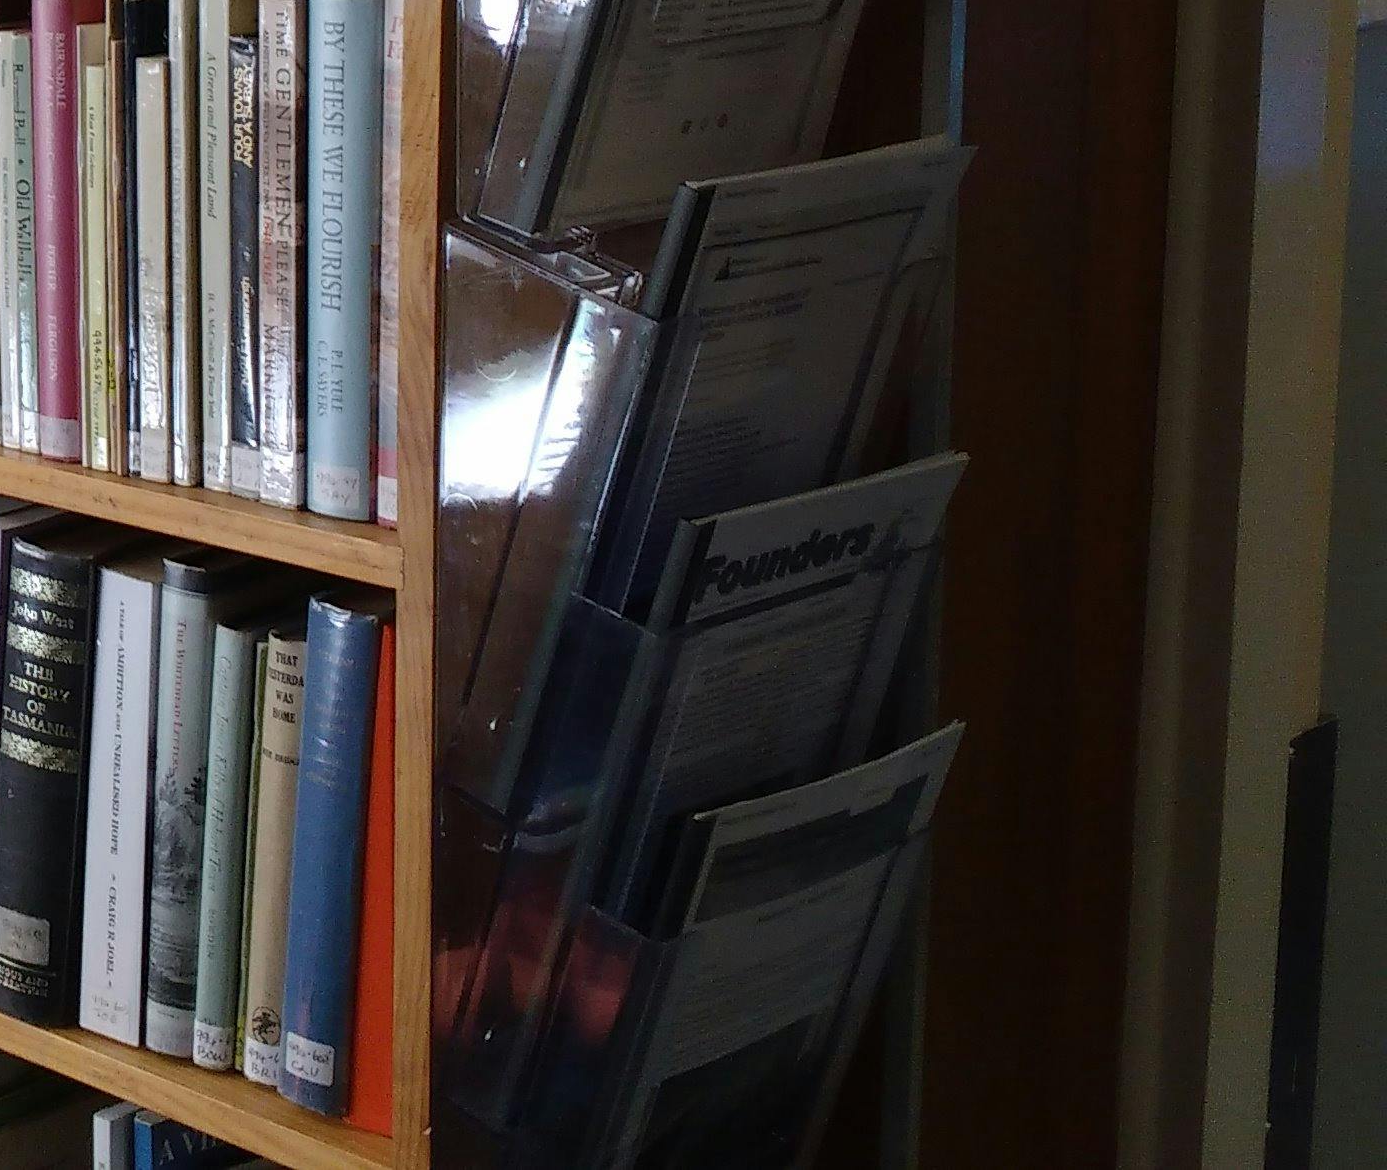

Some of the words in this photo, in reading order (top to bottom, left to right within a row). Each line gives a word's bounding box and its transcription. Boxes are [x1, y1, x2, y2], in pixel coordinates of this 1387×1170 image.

[320, 20, 346, 53] BY
[206, 67, 218, 99] Green
[320, 59, 346, 137] THESE
[206, 101, 217, 125] and
[205, 132, 218, 183] Pleasant
[320, 144, 345, 183] WE
[206, 188, 217, 219] Land
[319, 188, 345, 313] FLOURISH
[693, 524, 877, 602] Founders
[12, 601, 41, 623] John
[23, 661, 55, 681] THE
[274, 650, 300, 668] THAT
[8, 674, 71, 704] HISTORY
[112, 645, 126, 710] AMBITION
[25, 699, 48, 717] OF
[275, 690, 295, 705] WAS
[2, 709, 74, 739] TASMANIA
[271, 708, 297, 726] HOME
[110, 733, 124, 818] UNREALISED
[109, 819, 121, 856] HOPE
[106, 885, 120, 929] CRAIG
[105, 942, 118, 976] JOEL
